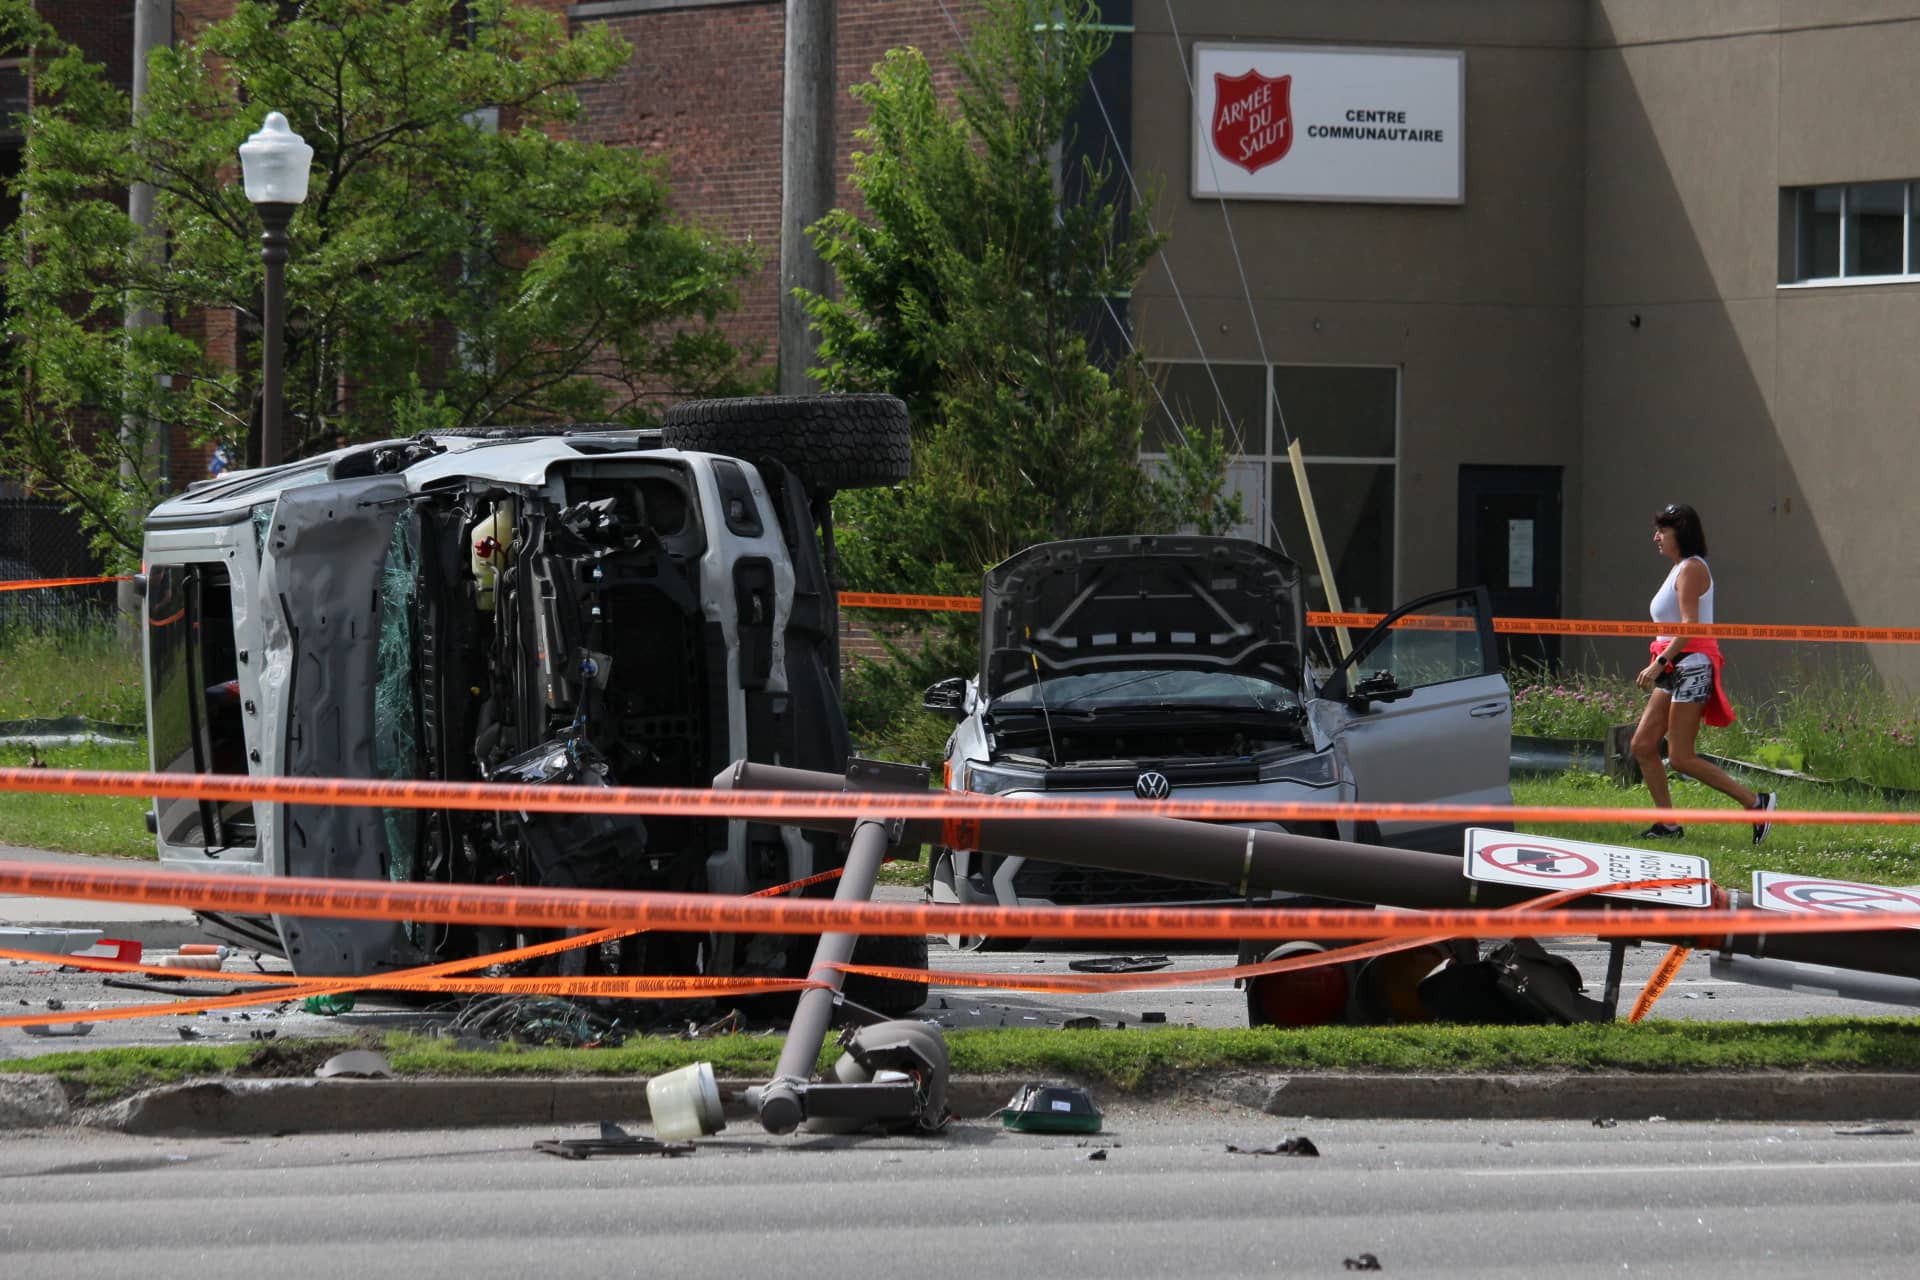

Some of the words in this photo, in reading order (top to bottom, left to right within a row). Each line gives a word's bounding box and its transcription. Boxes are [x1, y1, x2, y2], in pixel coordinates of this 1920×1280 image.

[1216, 82, 1272, 132] ARMÉE
[1249, 105, 1273, 134] DU
[1345, 109, 1407, 124] CENTRE
[1239, 117, 1288, 162] SALUT
[1307, 124, 1444, 143] COMMUNAUTAIRE
[1604, 852, 1630, 884] XCEPTÉ
[1640, 854, 1662, 896] LIAISON
[1670, 863, 1692, 894] LOALE
